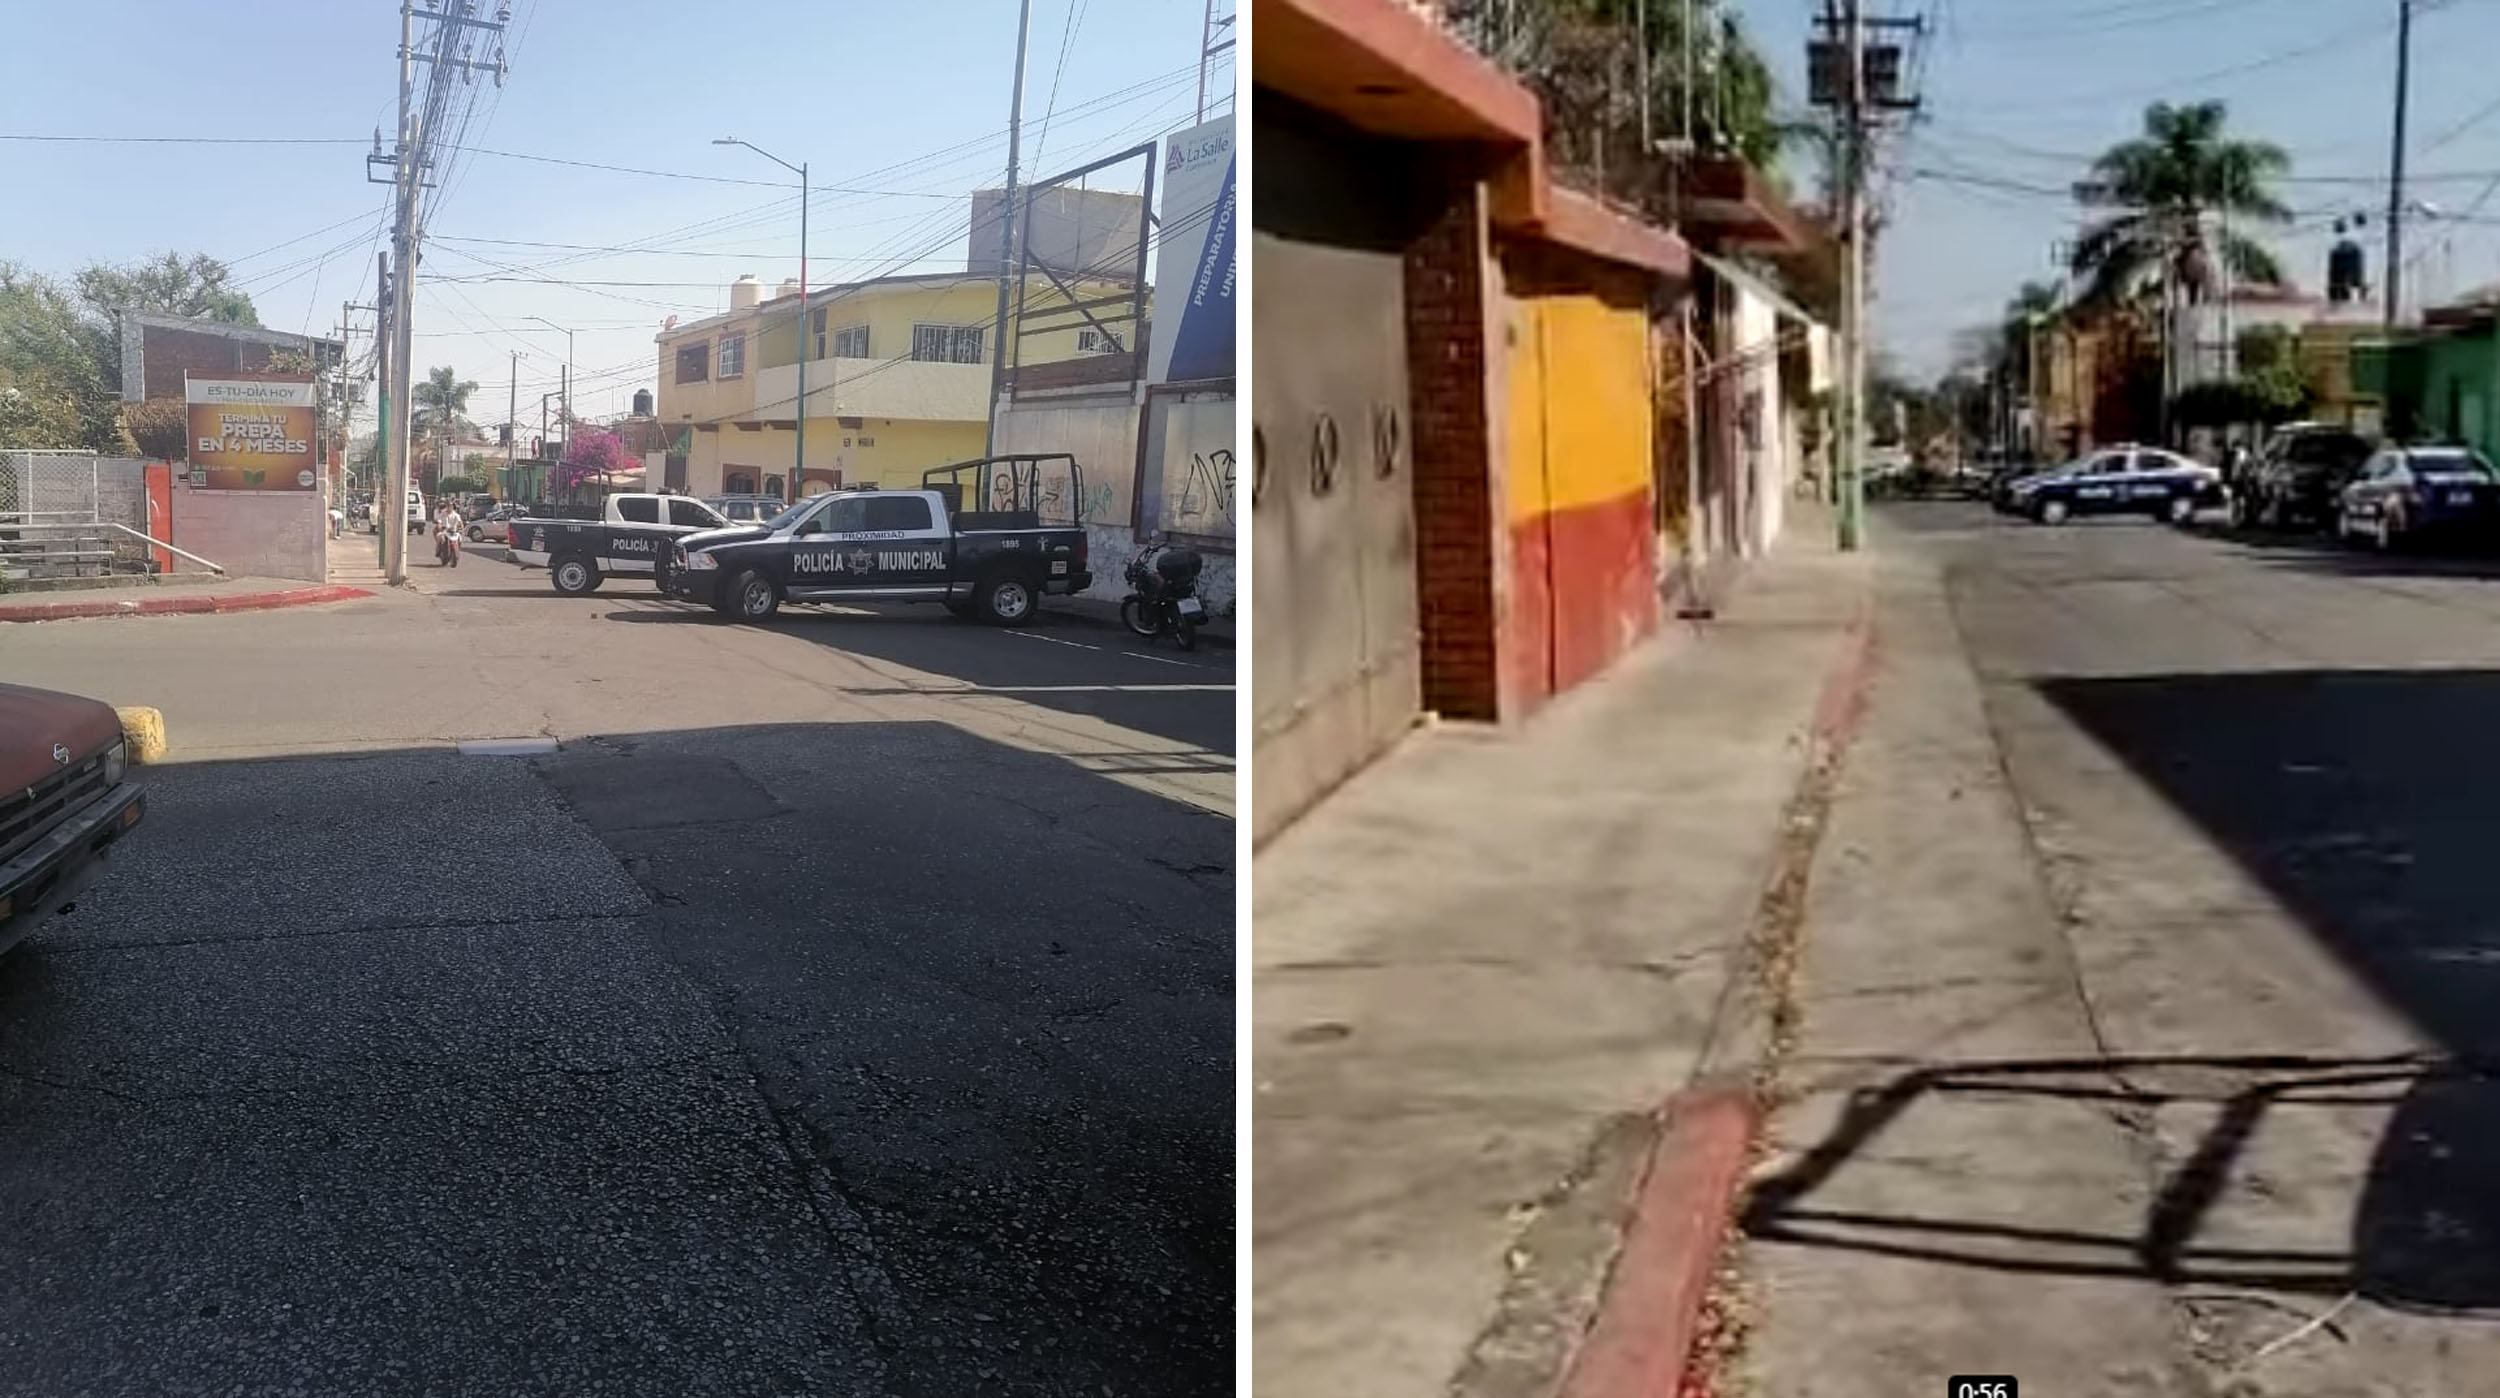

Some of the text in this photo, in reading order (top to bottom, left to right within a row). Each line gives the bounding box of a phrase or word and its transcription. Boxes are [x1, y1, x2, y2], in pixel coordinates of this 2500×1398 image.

[270, 388, 295, 398] HOY
[272, 414, 287, 424] TU
[221, 424, 285, 438] PREPA
[198, 437, 308, 453] EN 4 MESES
[841, 531, 905, 541] PROXIMIDAD
[612, 538, 649, 552] POLICÍA
[793, 550, 947, 573] POLICÍA MUNICIPAL
